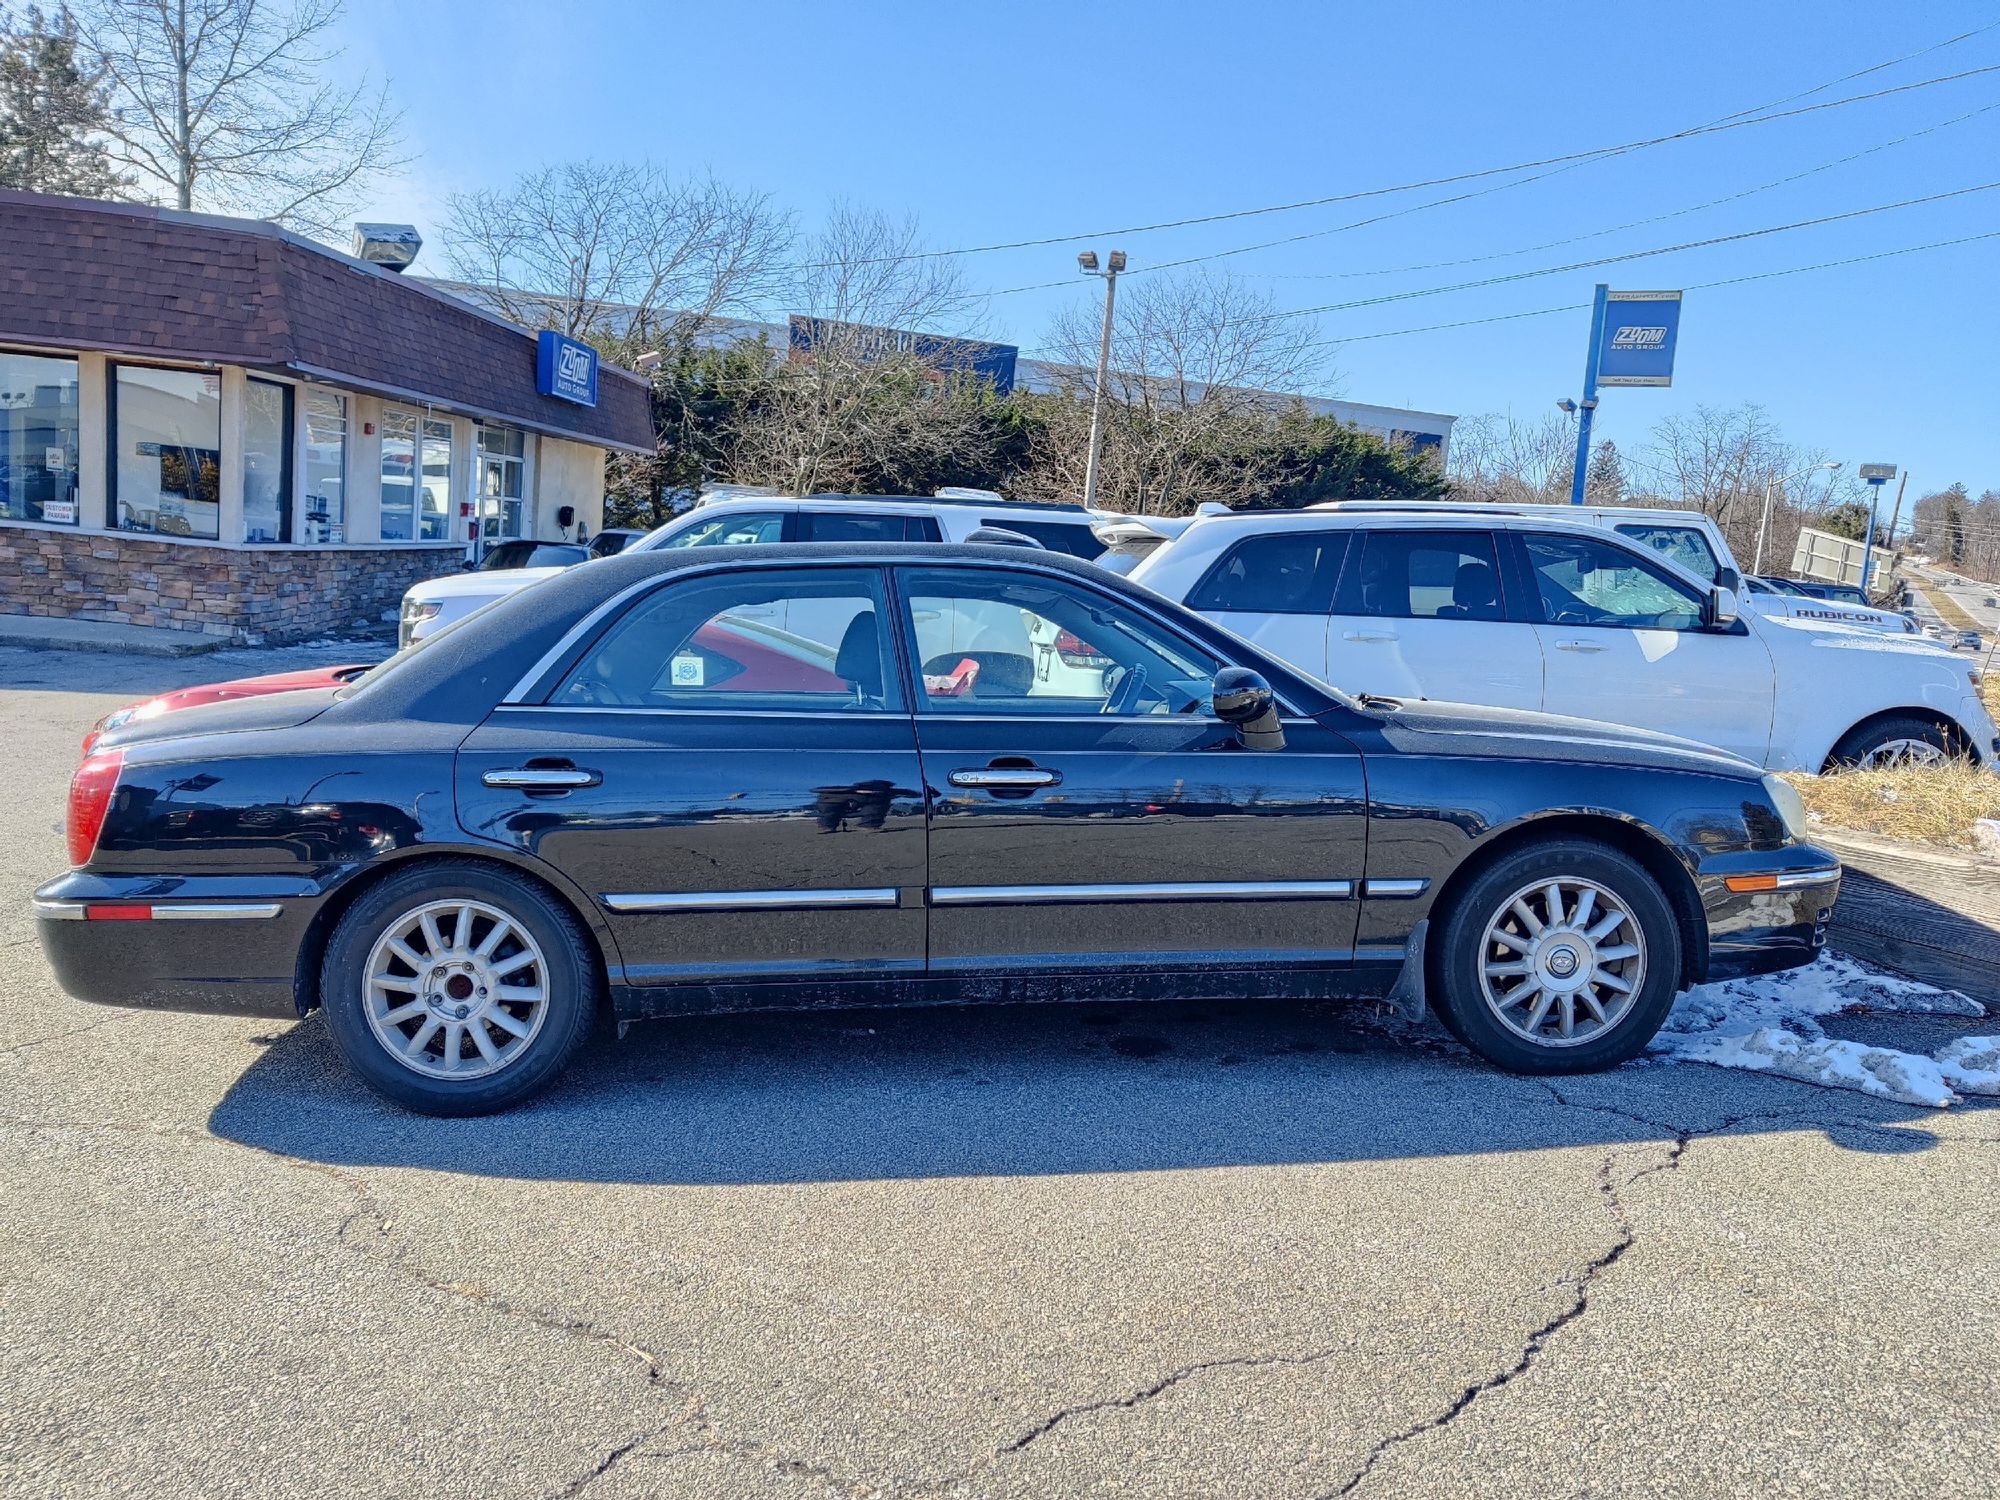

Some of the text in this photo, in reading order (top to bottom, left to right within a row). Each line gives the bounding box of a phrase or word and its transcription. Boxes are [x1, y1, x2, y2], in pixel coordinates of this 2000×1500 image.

[1616, 328, 1664, 343] ZOOM
[560, 347, 588, 382] ZOOM
[558, 380, 590, 398] AUTO GROUP
[45, 504, 72, 512] CUSTOMER
[47, 512, 70, 520] PARKING
[1796, 609, 1883, 623] RUBICON
